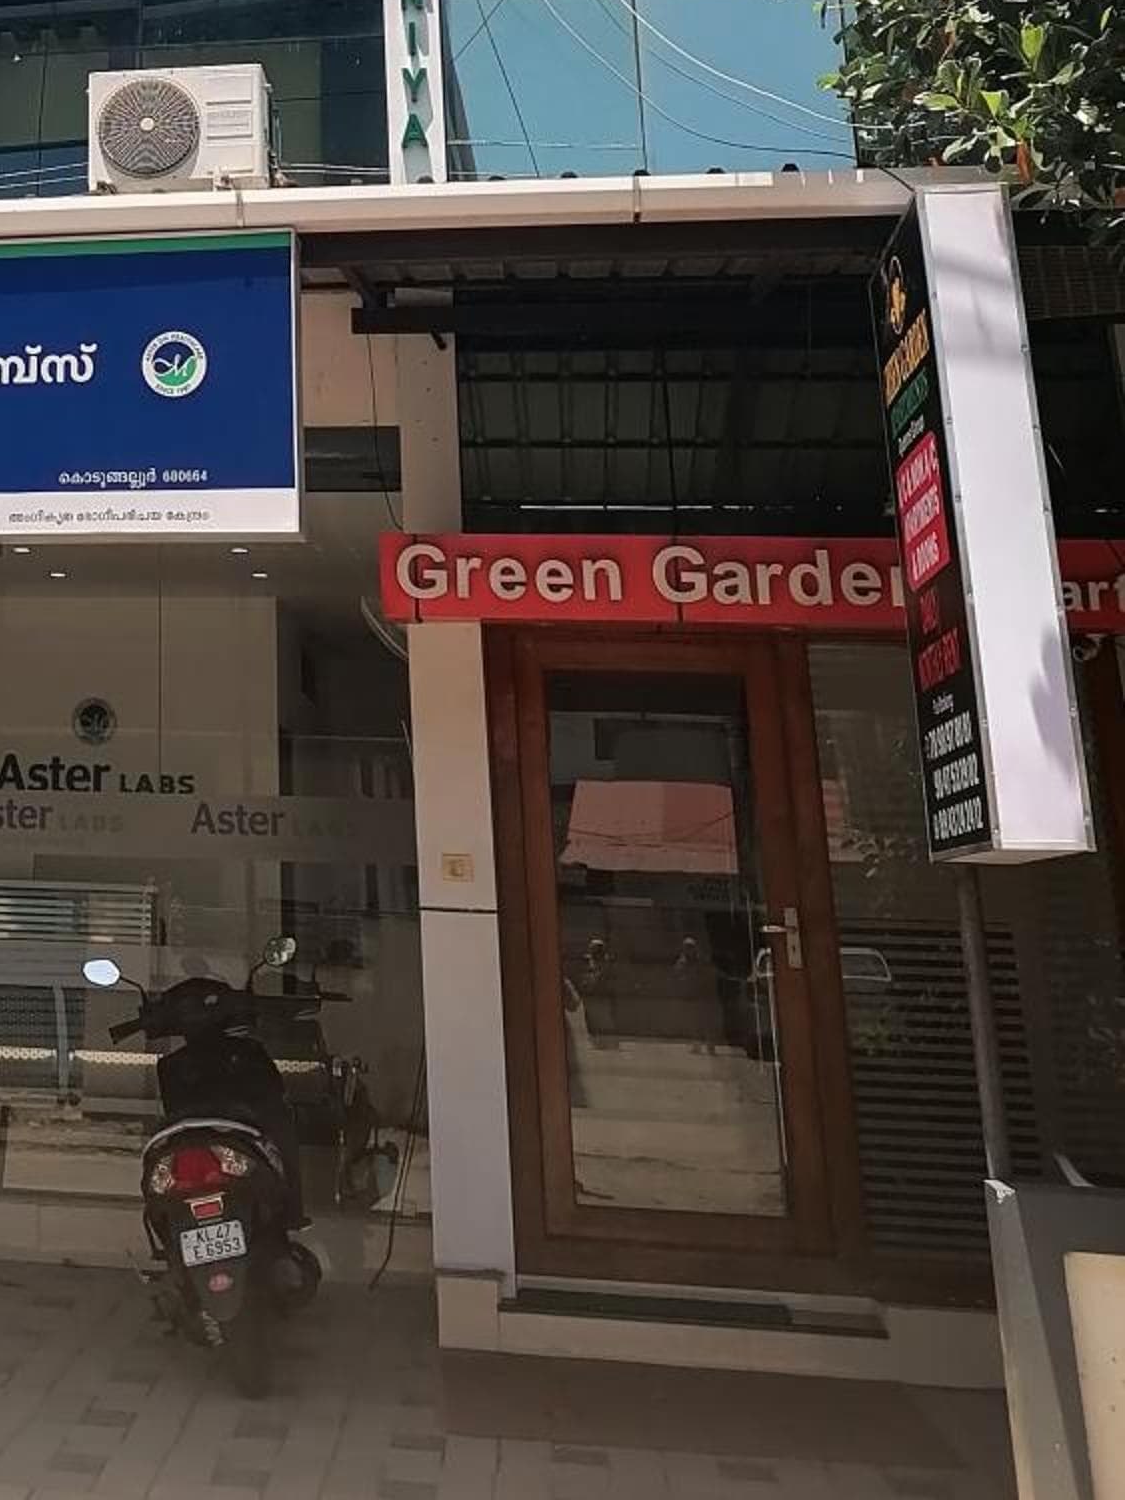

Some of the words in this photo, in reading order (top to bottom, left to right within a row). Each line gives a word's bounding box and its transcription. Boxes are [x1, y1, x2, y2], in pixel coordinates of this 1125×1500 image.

[396, 543, 623, 602] Green
[120, 775, 195, 795] LABS
[190, 799, 285, 836] Aster
[197, 1229, 215, 1243] KL
